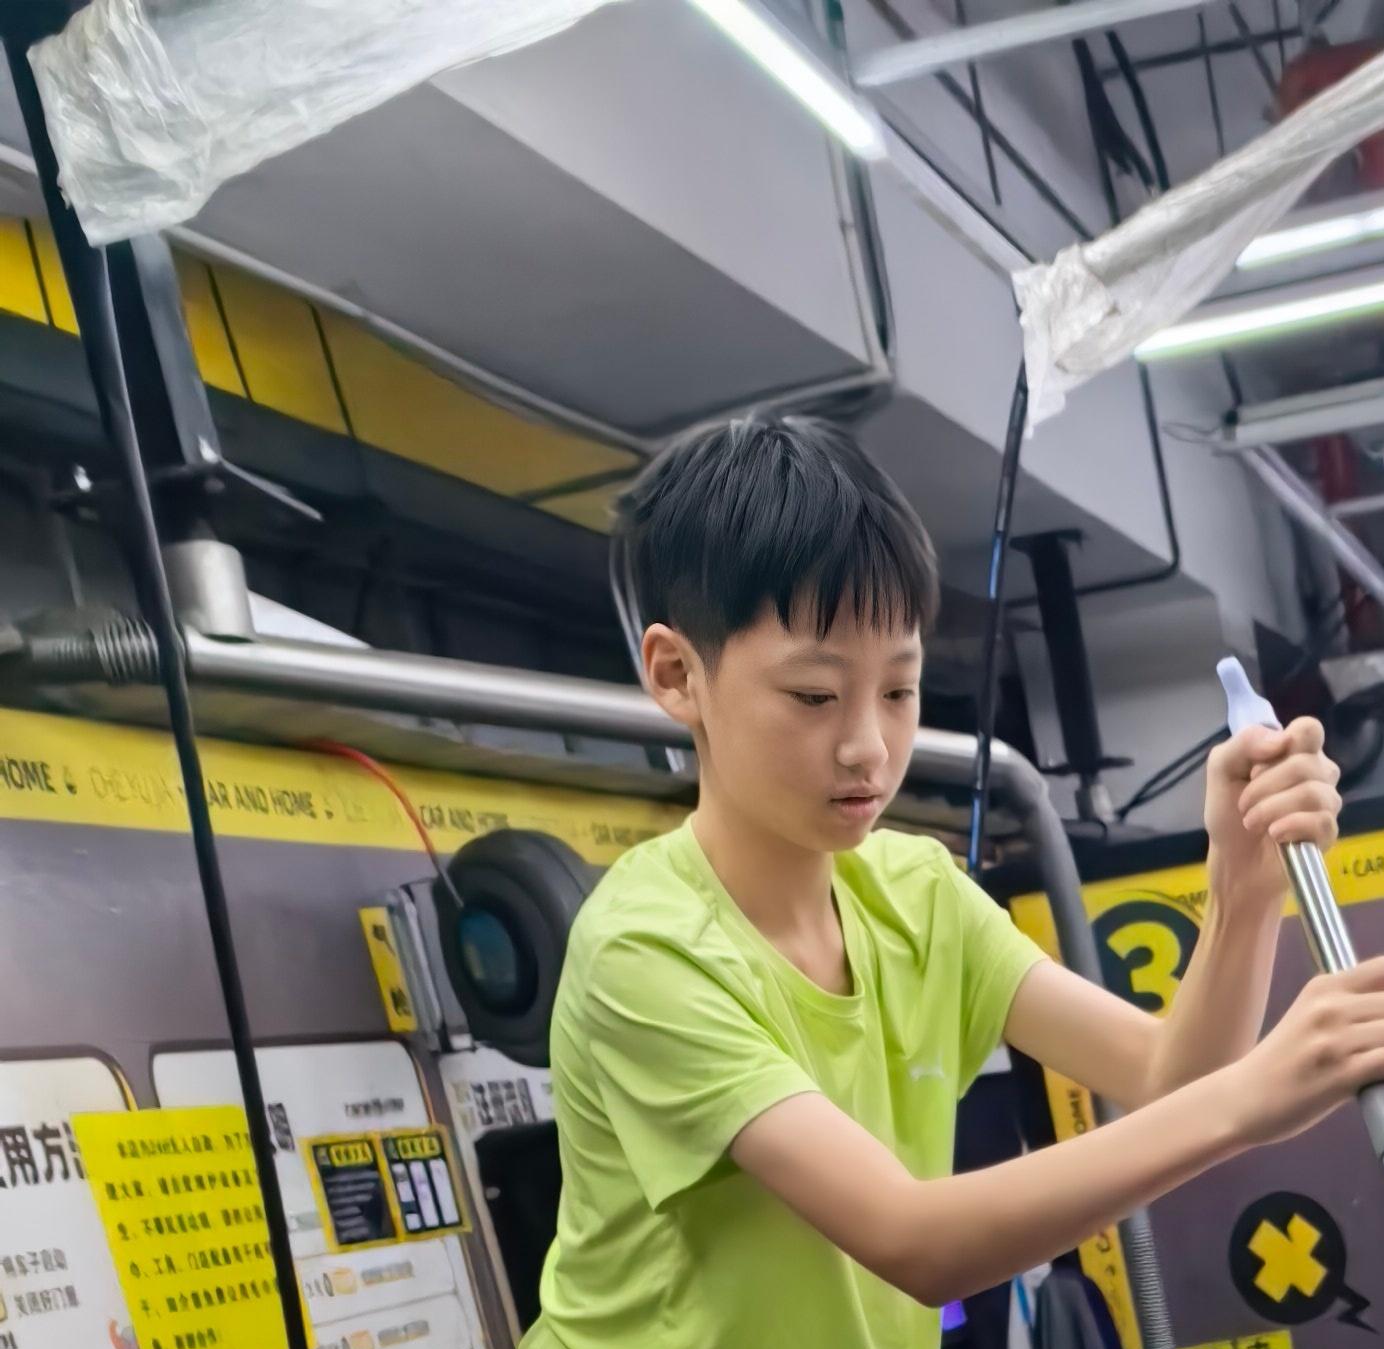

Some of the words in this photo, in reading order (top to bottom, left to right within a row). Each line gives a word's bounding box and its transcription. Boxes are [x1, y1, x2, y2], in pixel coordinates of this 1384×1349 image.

[234, 785, 269, 816] AND
[270, 789, 318, 820] HOME
[1106, 921, 1182, 1019] 3
[0, 1120, 85, 1189] 用方
